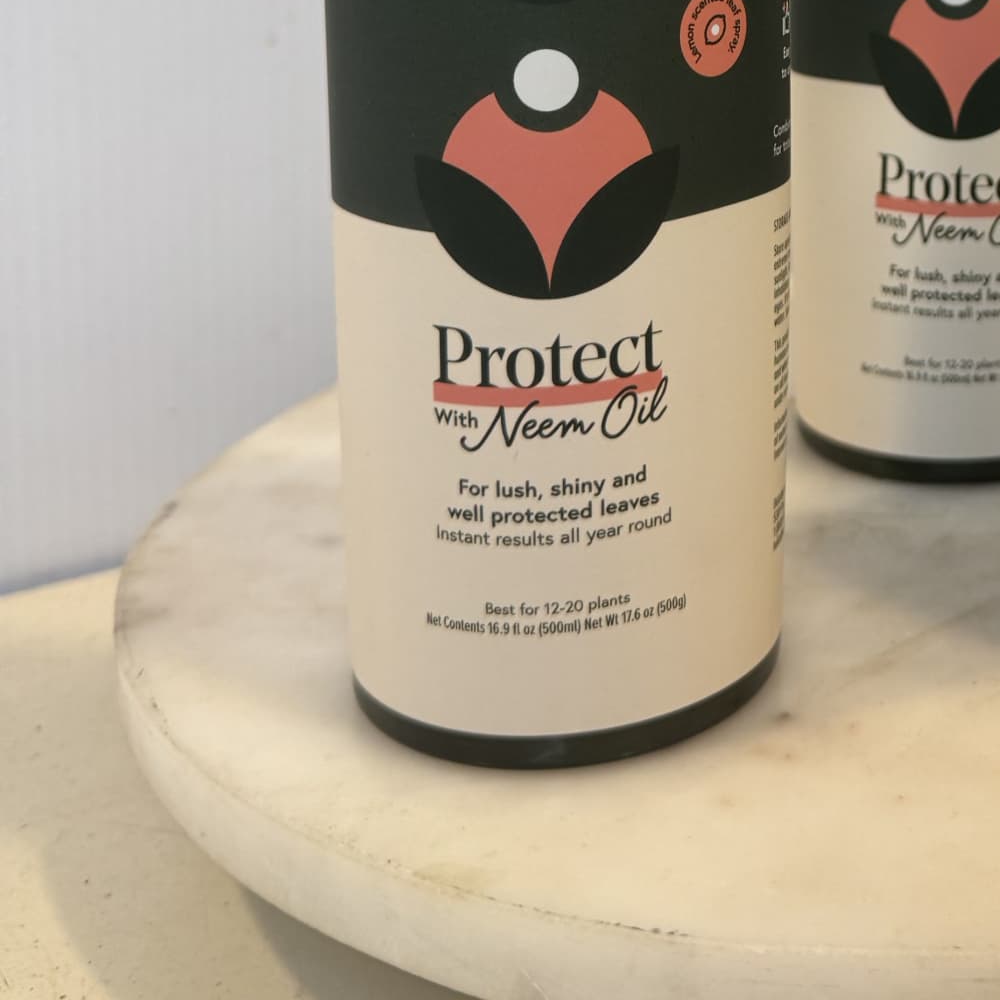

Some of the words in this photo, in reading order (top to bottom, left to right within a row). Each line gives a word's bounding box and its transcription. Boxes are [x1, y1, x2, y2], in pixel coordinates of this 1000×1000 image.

[687, 23, 702, 64] Lemon
[875, 212, 906, 229] With
[893, 211, 984, 245] Neem
[881, 283, 907, 297] well
[910, 287, 982, 301] protected
[890, 264, 910, 279] For
[915, 266, 947, 284] lush,
[952, 270, 991, 286] shiny
[433, 320, 662, 389] Protect
[434, 407, 478, 428] With
[460, 400, 595, 451] Neem
[601, 375, 668, 439] Oil
[458, 478, 489, 497] For
[496, 480, 543, 501] lush,
[550, 477, 605, 497] shiny
[612, 464, 647, 489] and
[436, 524, 490, 546] Instant
[496, 530, 554, 547] results
[560, 528, 580, 544] all
[586, 522, 622, 546] year
[628, 506, 672, 533] round
[448, 504, 484, 522] well
[491, 502, 593, 528] protected
[601, 490, 660, 516] leaves
[426, 612, 442, 626] Net
[443, 616, 486, 633] Contents
[488, 622, 510, 635] 16.9
[513, 622, 521, 635] fl
[523, 624, 536, 635] oz
[538, 619, 581, 637] (500ml)
[584, 617, 602, 631] Net
[605, 613, 619, 627] Wt
[621, 607, 641, 624] 17.6
[643, 606, 654, 618] oz
[656, 593, 687, 616] (500g)
[485, 602, 516, 616] Best
[520, 602, 539, 616] for
[544, 600, 584, 615] 12-20
[588, 594, 631, 614] plants
